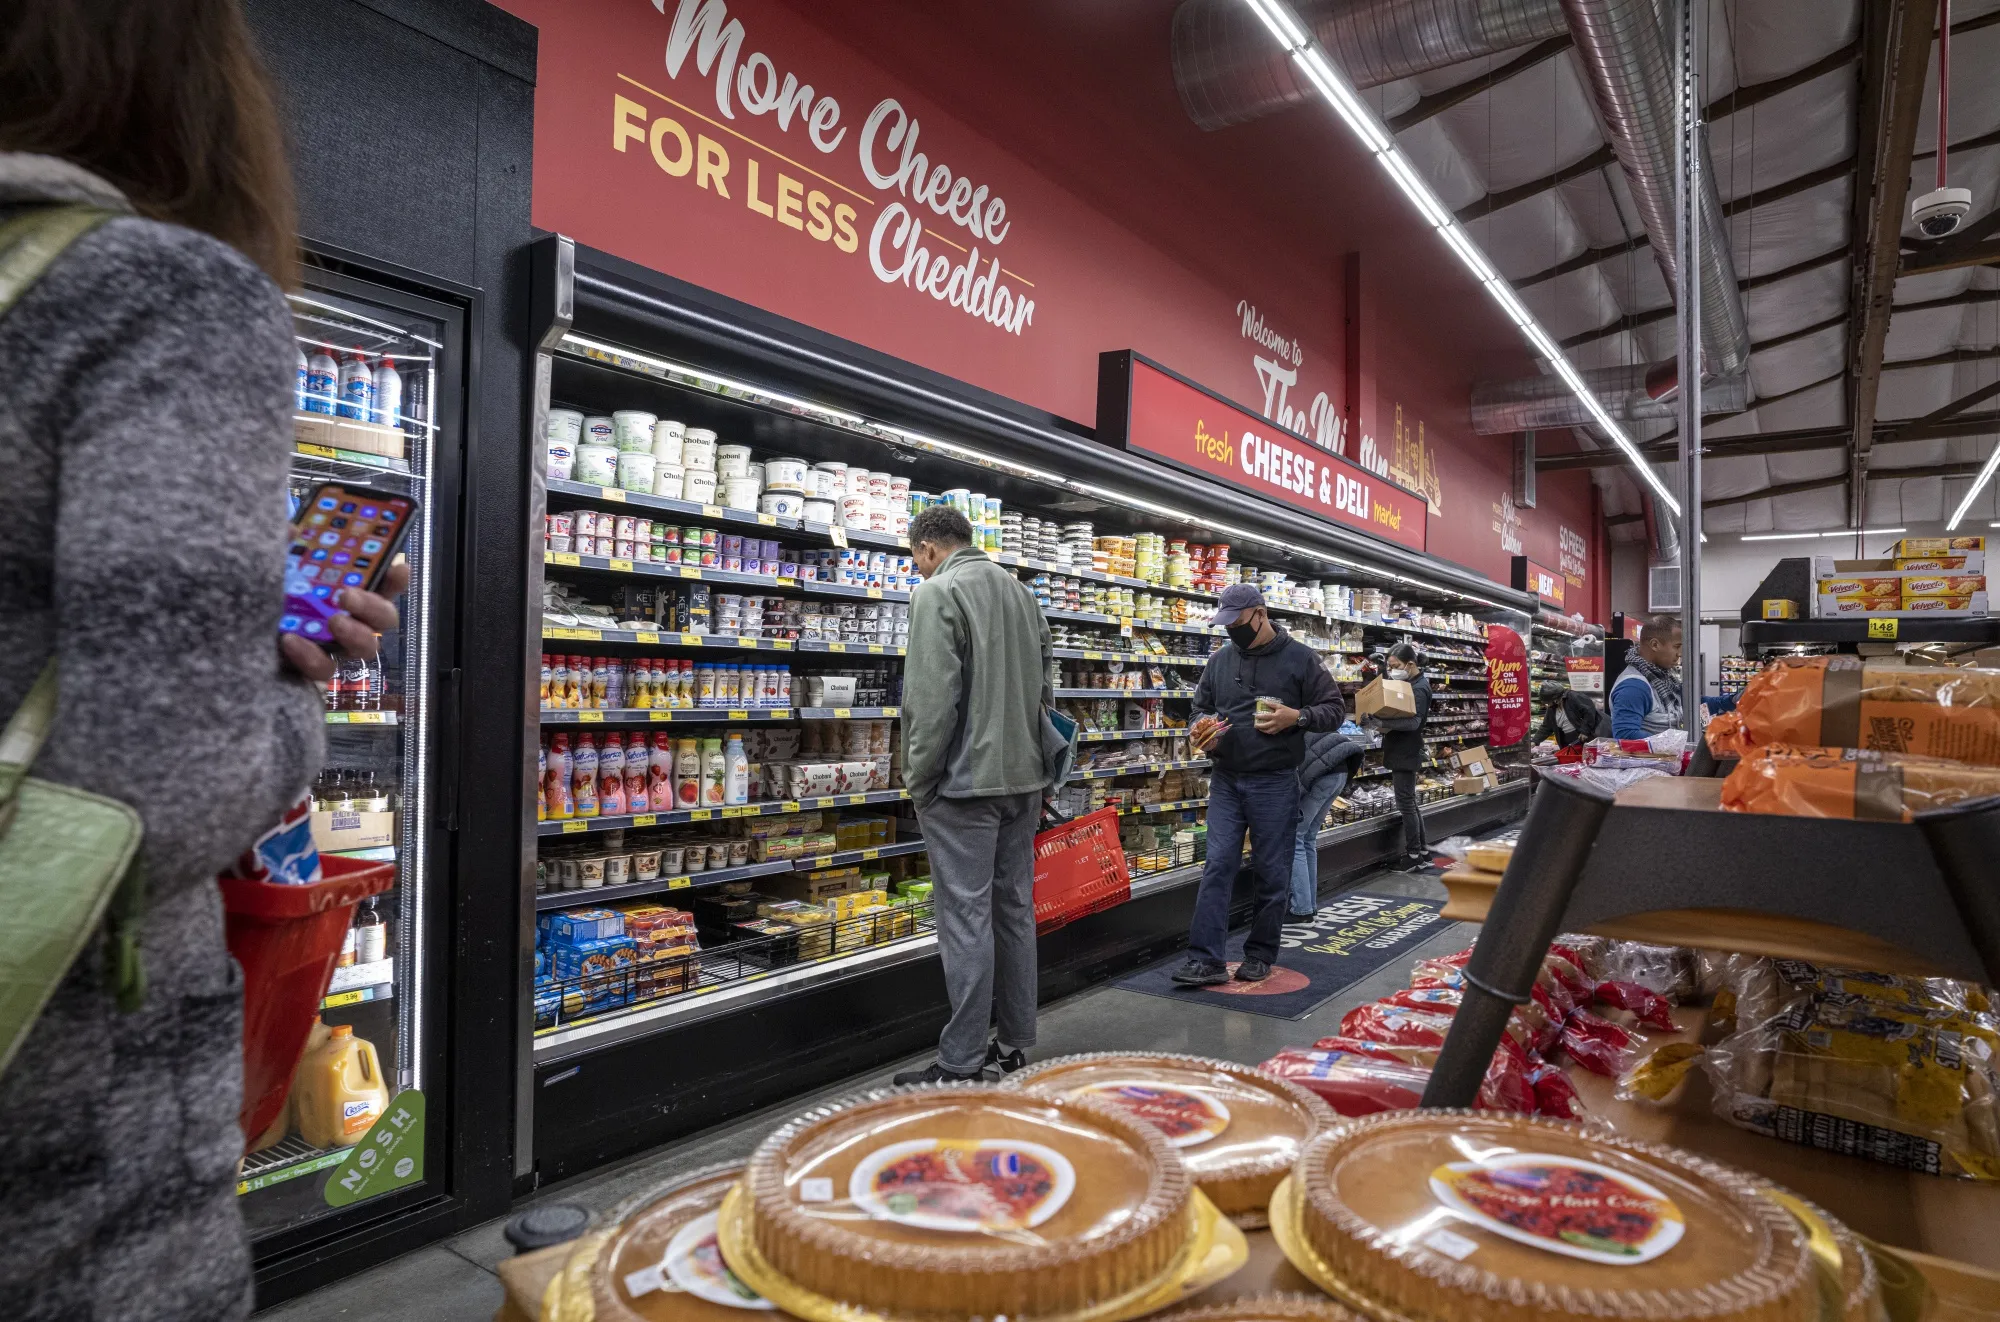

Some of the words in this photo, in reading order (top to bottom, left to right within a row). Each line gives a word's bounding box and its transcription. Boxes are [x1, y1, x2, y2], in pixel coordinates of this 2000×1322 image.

[652, 0, 846, 153] More
[859, 98, 1010, 245] Cheese
[613, 93, 730, 199] FOR
[747, 158, 859, 254] LESS
[869, 202, 1034, 336] Cheddar
[1237, 300, 1291, 360] Welcome
[1291, 338, 1304, 366] to
[1194, 419, 1233, 467] fresh
[1240, 431, 1315, 499] CHEESE
[1319, 466, 1332, 503] &
[1335, 474, 1370, 520] DELI
[1373, 497, 1402, 532] market
[1559, 525, 1568, 550] SO
[1568, 529, 1586, 561] FRESH
[693, 593, 709, 602] KETO
[1538, 572, 1553, 597] MEAT
[1828, 583, 1860, 593] Velveeta
[1909, 581, 1944, 590] Velveeta
[1838, 603, 1861, 611] lveeta
[1911, 601, 1943, 610] Velveeta
[1488, 658, 1522, 682] Yum
[1490, 680, 1519, 697] Run
[812, 772, 832, 781] Chobani
[850, 770, 868, 778] Chobani
[1365, 912, 1441, 949] GUARANTEED
[1914, 1138, 1925, 1170] OMES
[1925, 1141, 1938, 1173] ROM
